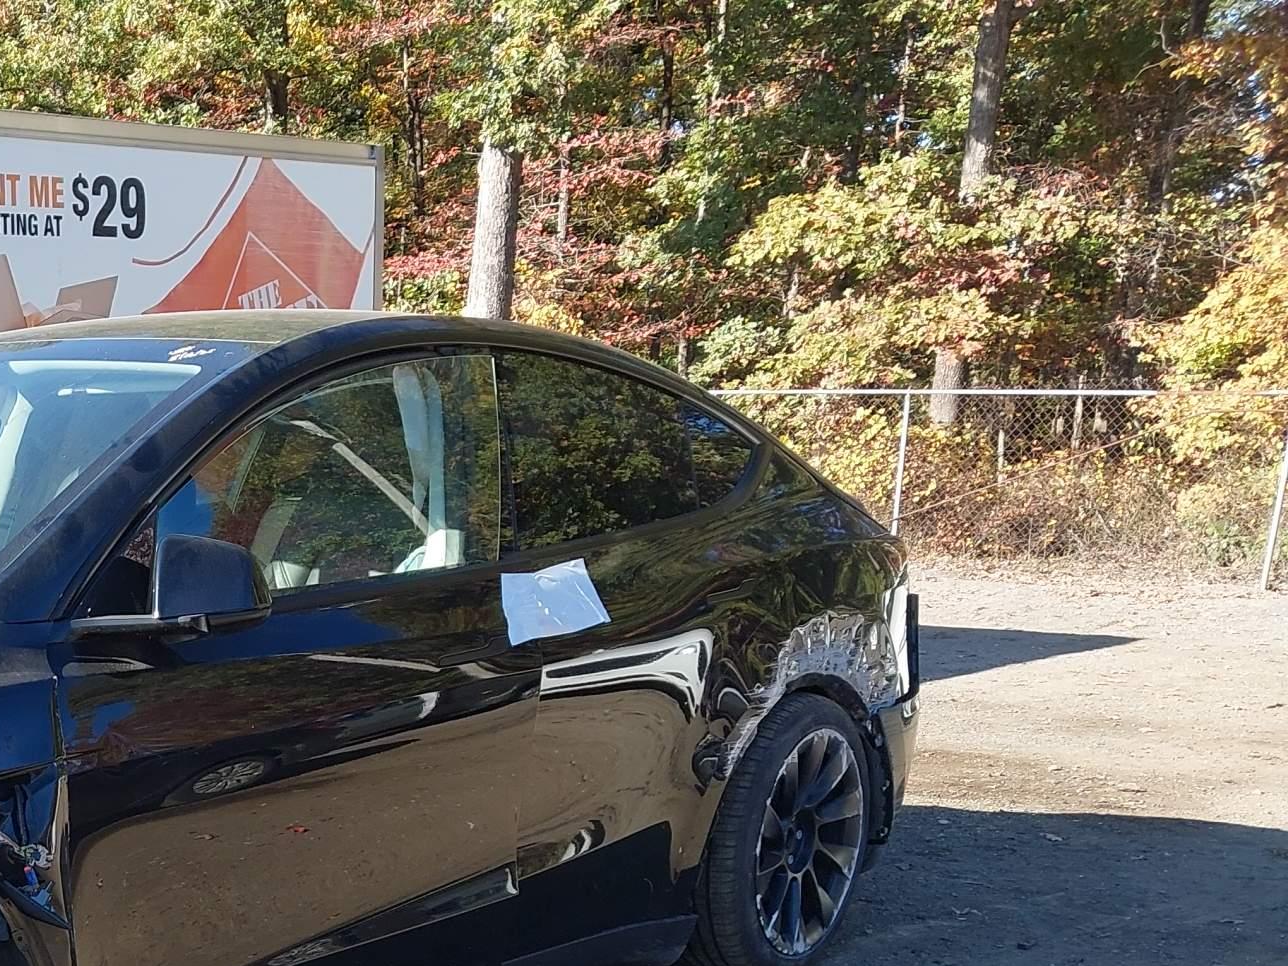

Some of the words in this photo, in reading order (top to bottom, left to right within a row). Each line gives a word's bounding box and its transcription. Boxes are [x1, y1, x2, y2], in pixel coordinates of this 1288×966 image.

[29, 174, 65, 209] ME
[71, 172, 146, 240] $29
[43, 214, 63, 237] AT
